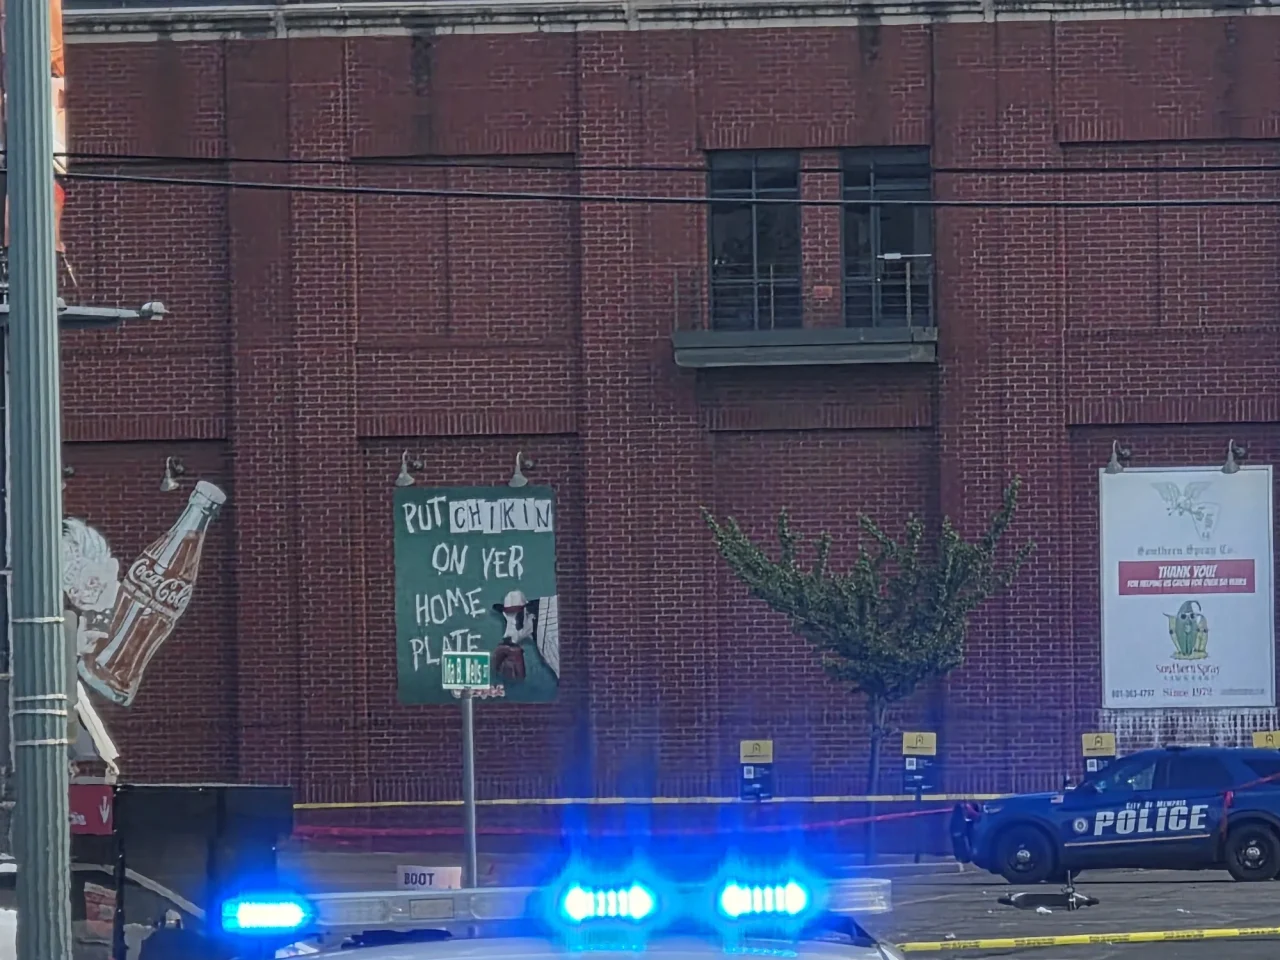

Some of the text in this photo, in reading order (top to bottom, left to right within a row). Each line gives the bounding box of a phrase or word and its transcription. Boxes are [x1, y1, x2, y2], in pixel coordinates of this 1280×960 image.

[402, 496, 550, 534] PUT CHIKIN
[432, 542, 524, 580] ON YER
[1158, 564, 1218, 579] THANK YOU!
[416, 587, 486, 626] HOME
[444, 657, 455, 684] Ida
[465, 657, 482, 684] Wells
[1162, 687, 1190, 697] Since
[1094, 804, 1209, 836] POLICE
[404, 872, 435, 886] BOOT
